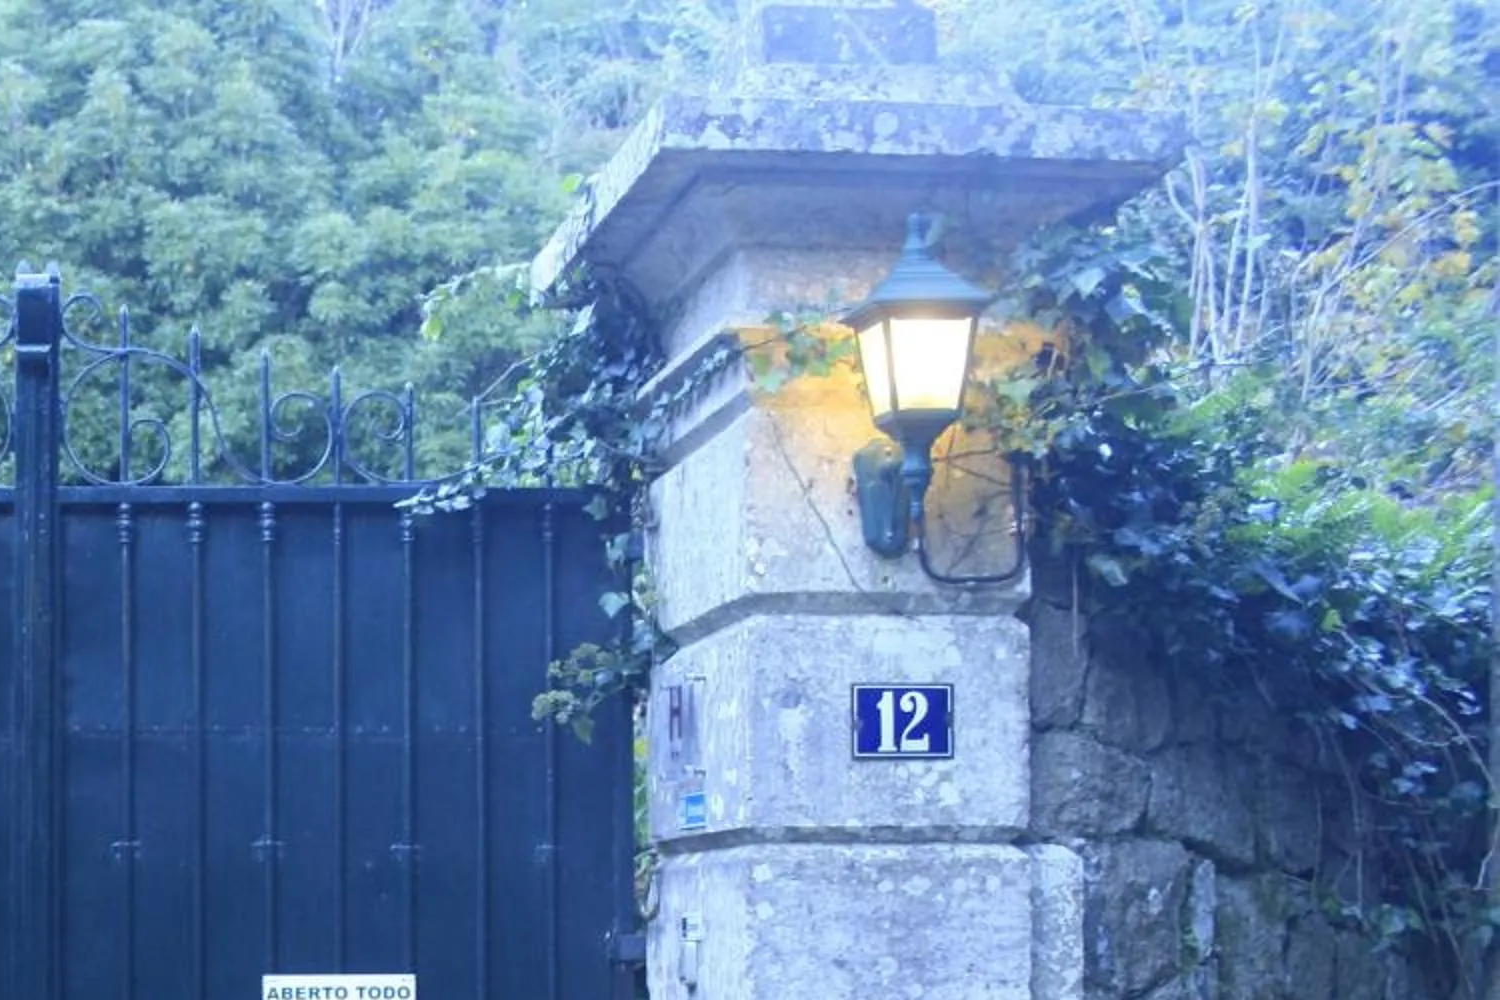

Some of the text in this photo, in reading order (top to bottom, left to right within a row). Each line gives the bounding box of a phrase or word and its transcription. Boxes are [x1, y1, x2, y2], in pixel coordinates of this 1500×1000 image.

[877, 691, 930, 752] 12
[266, 986, 411, 1000] ABERTO TODO
